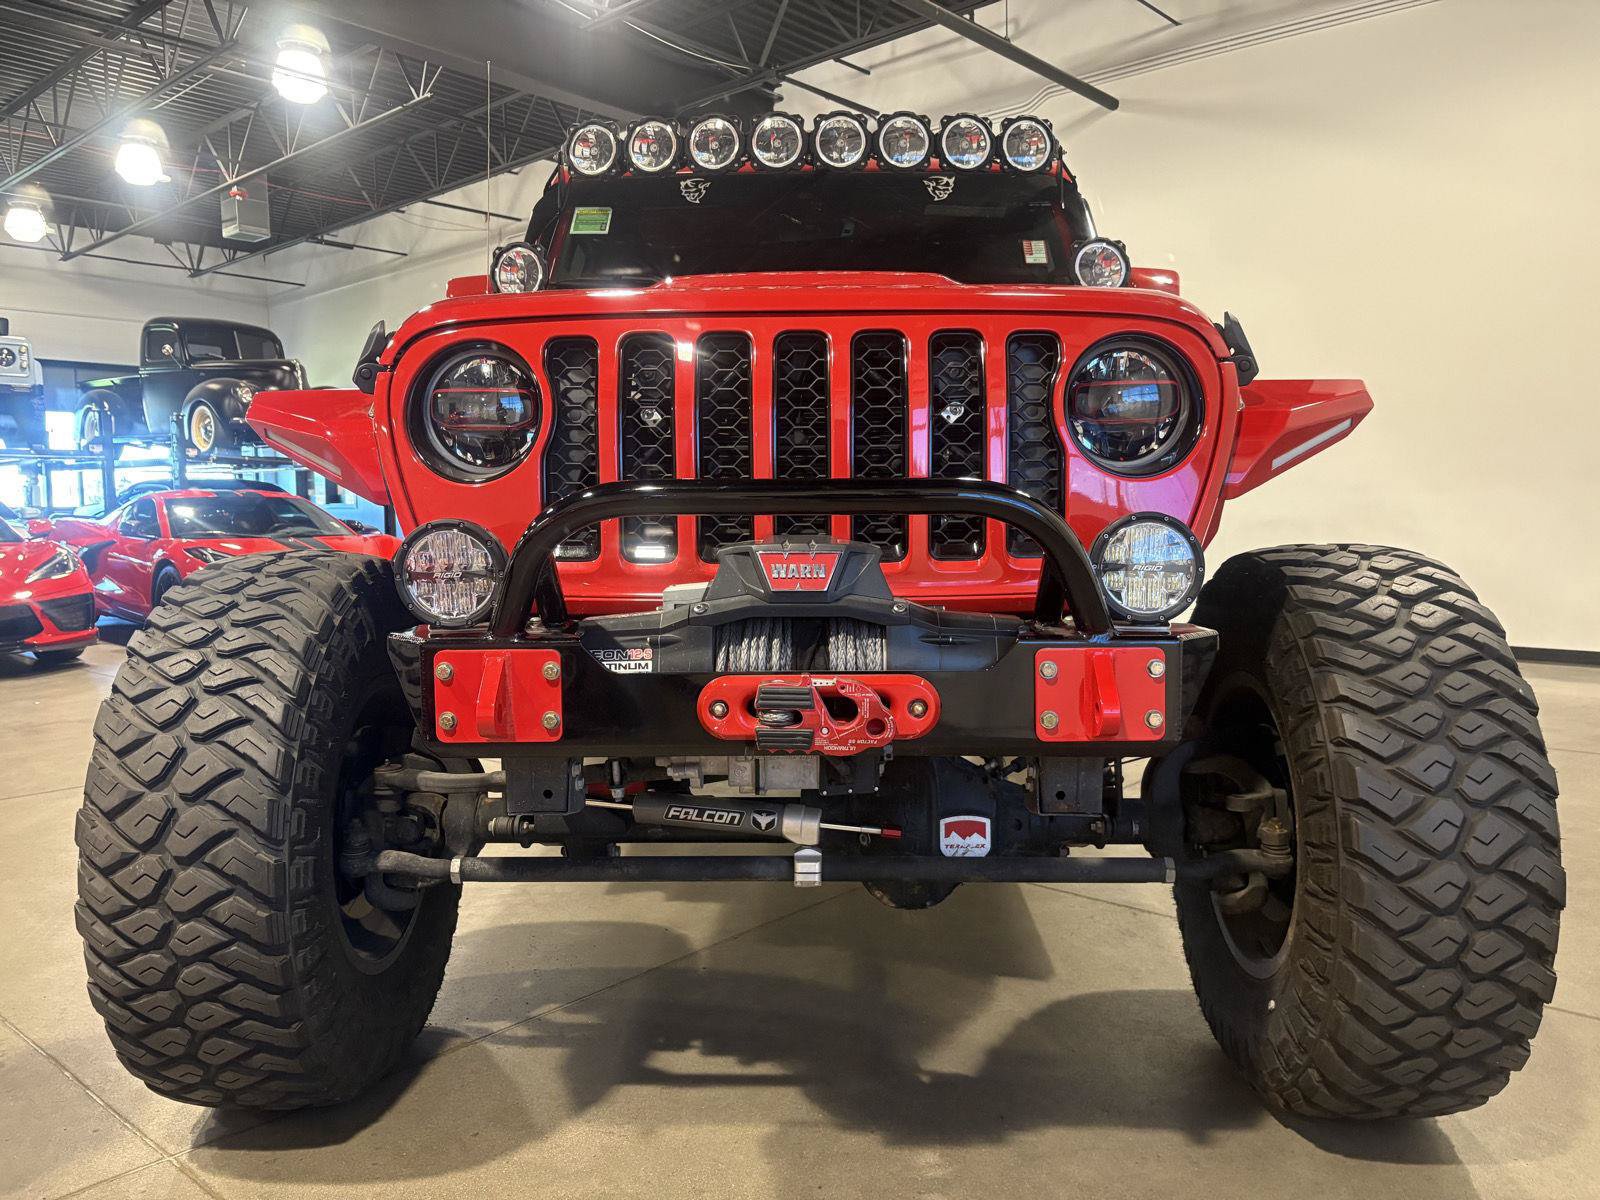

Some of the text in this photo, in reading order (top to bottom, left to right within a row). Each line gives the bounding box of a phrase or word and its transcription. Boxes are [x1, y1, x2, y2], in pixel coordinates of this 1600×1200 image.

[770, 563, 827, 579] WARN
[605, 662, 650, 671] TINUM
[668, 807, 741, 825] FALCON
